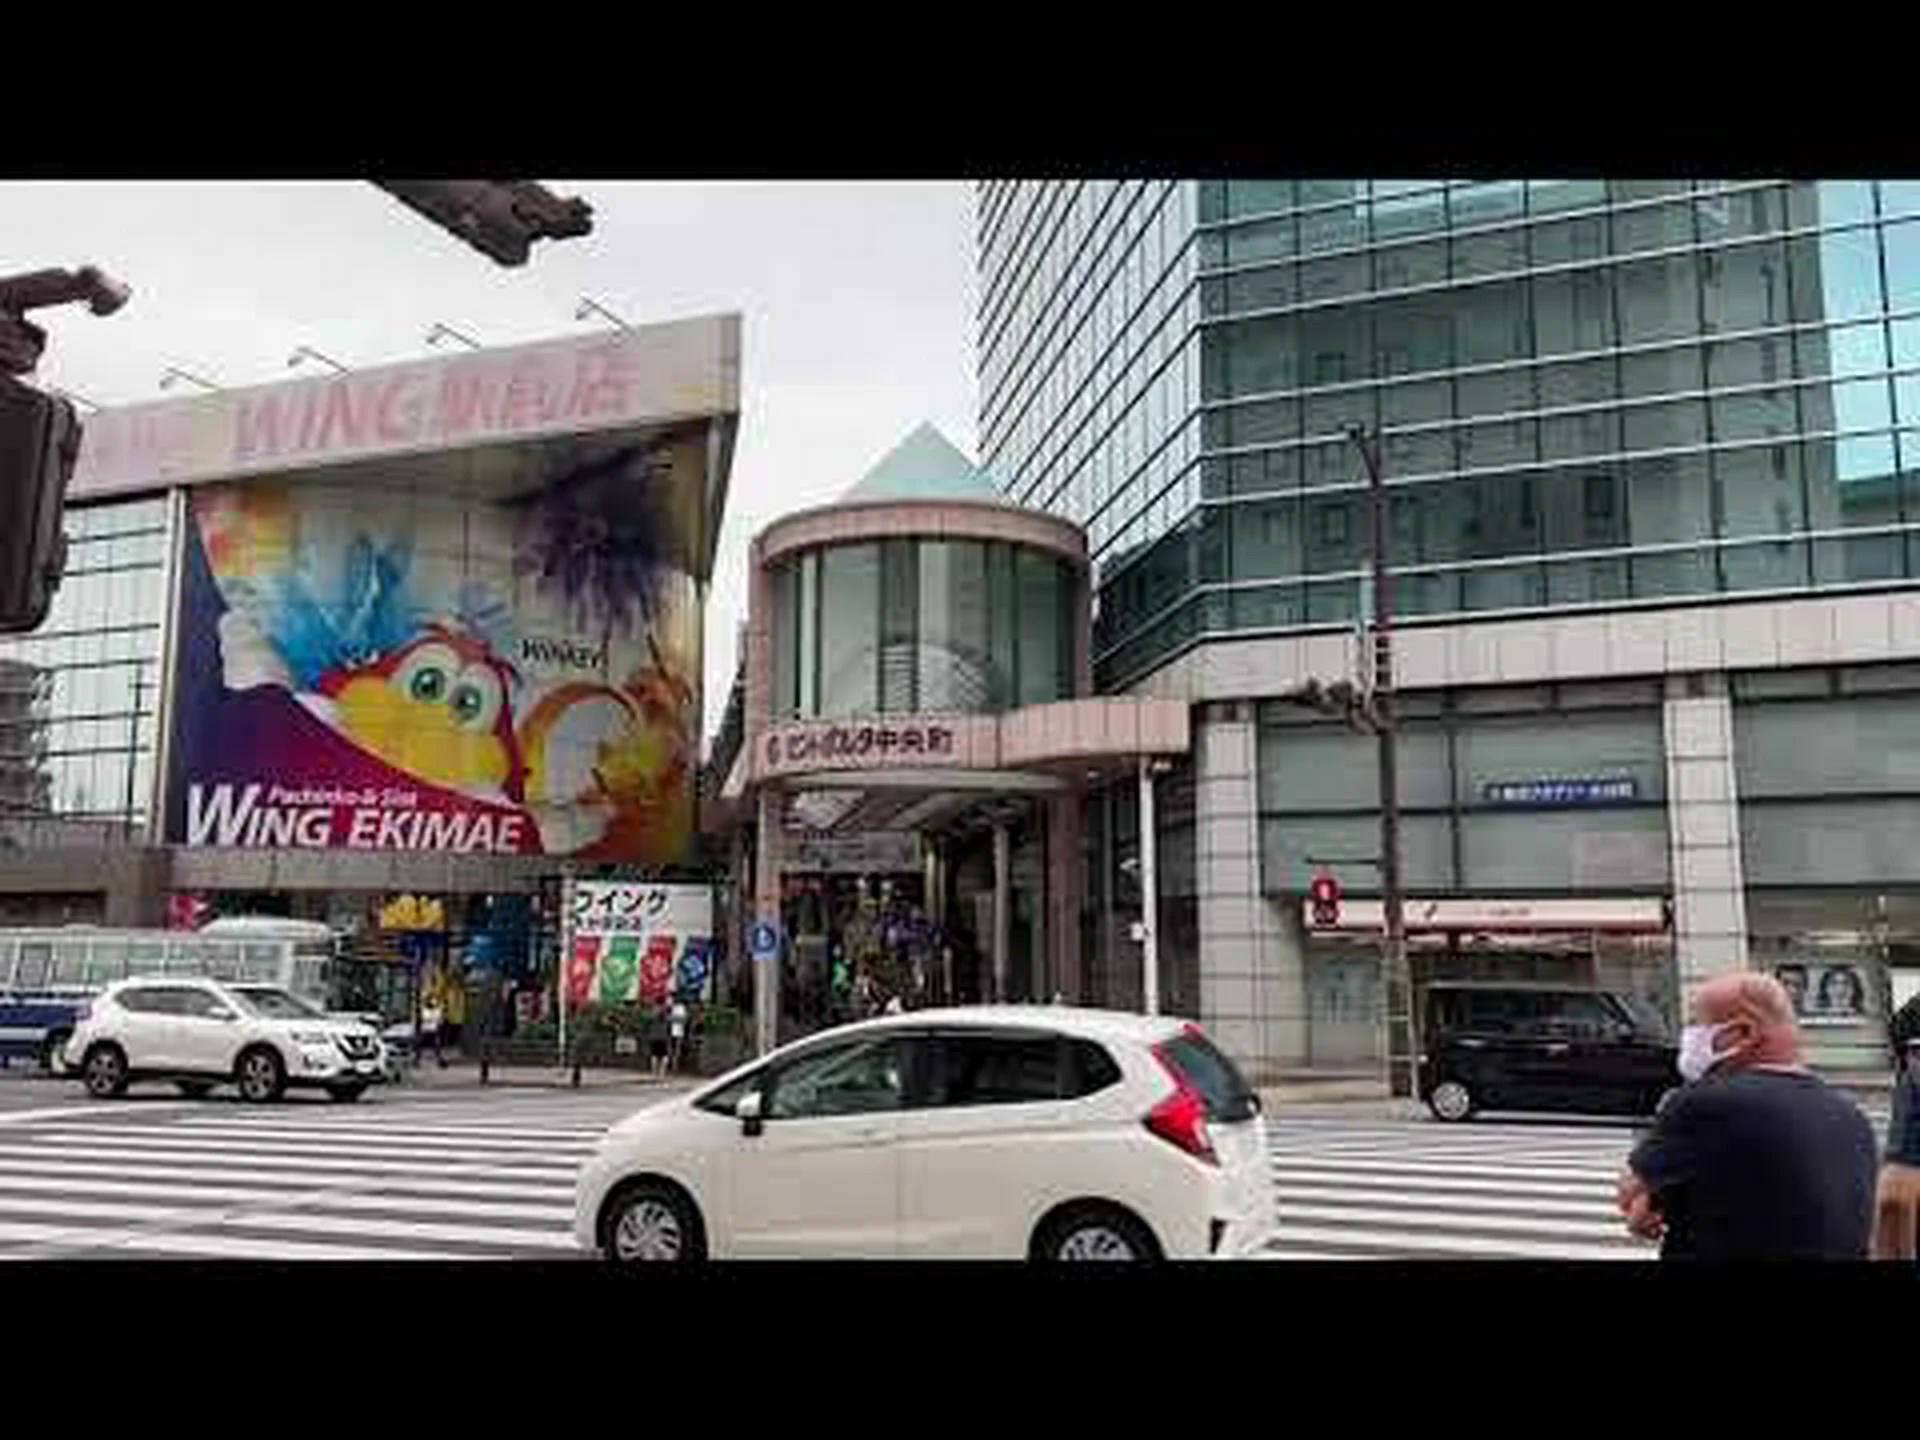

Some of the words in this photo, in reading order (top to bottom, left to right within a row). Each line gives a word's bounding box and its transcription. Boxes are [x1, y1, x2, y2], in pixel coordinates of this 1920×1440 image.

[234, 372, 427, 458] WING
[187, 784, 335, 849] WING
[347, 808, 523, 852] EKIMAE
